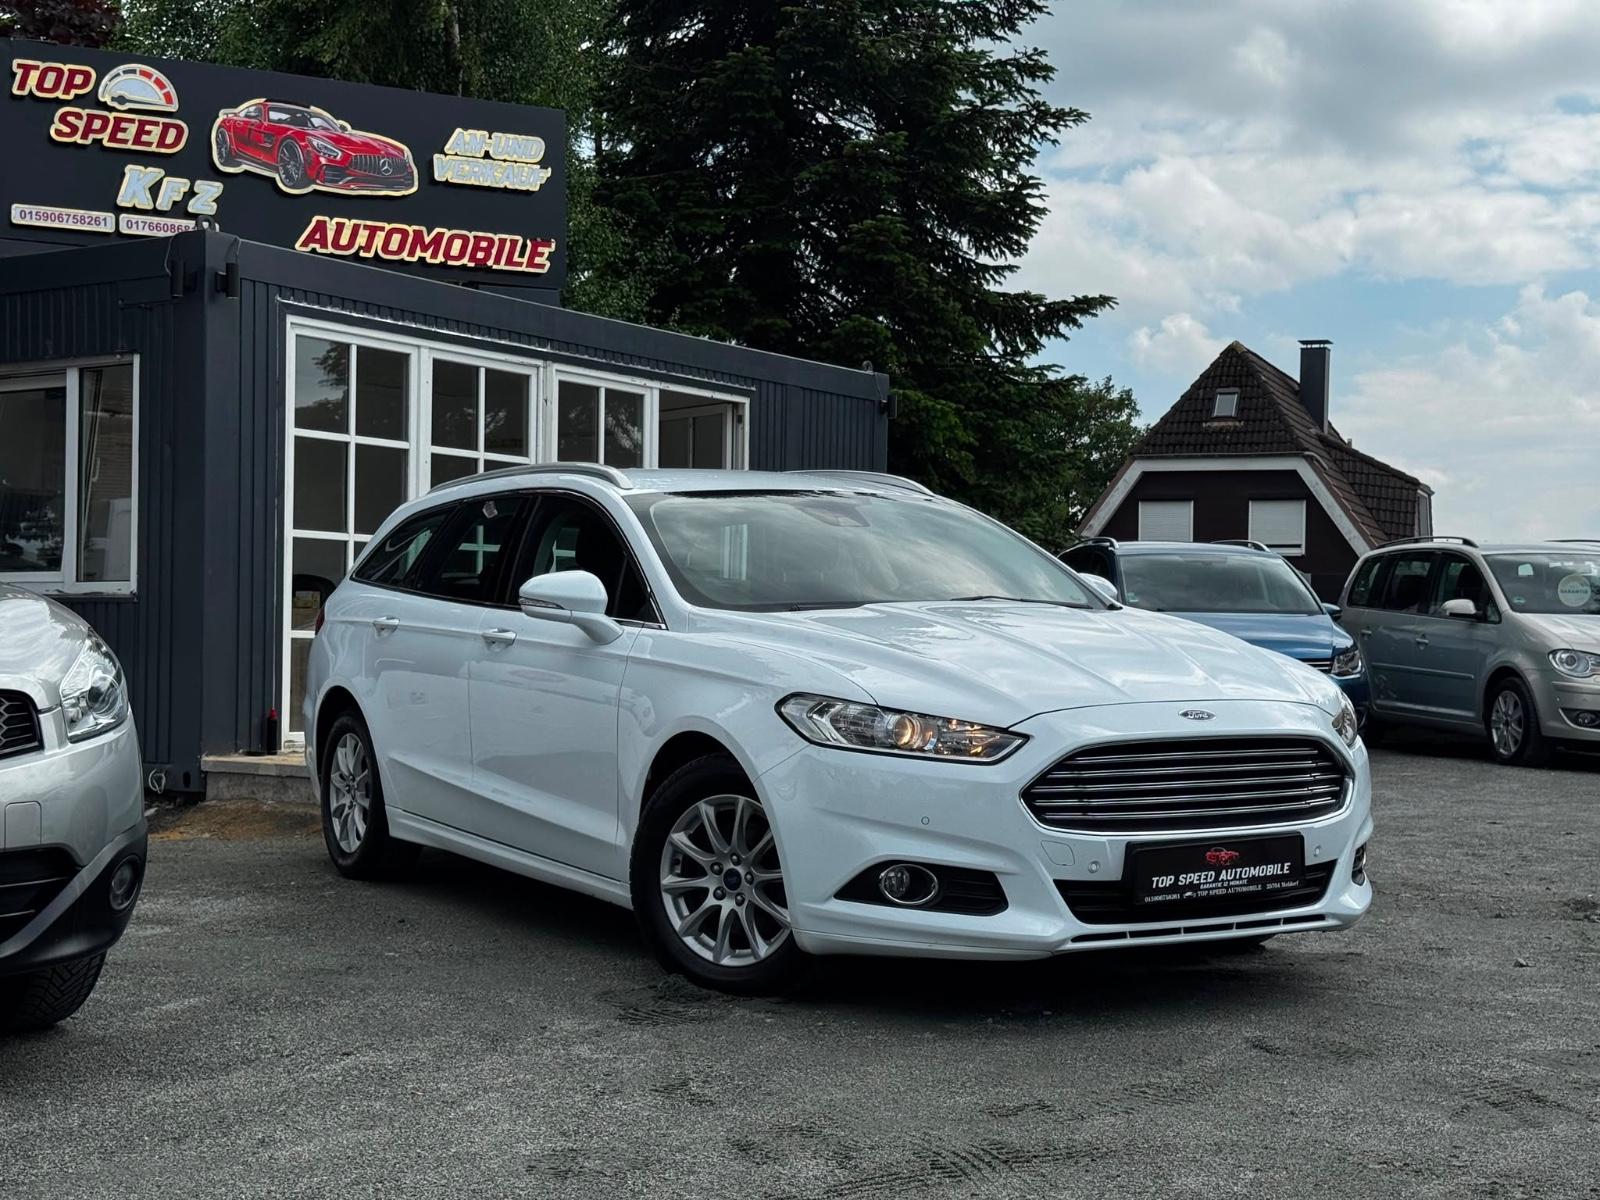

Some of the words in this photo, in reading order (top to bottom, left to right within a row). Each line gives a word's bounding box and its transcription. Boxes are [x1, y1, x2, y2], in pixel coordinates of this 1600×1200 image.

[13, 60, 95, 99] TOP
[51, 107, 188, 153] SPEED
[433, 154, 551, 191] VERKAUF
[19, 209, 107, 227] 015906758261
[296, 217, 555, 272] AUTOMOBILE
[1152, 876, 1175, 888] TOP
[1178, 871, 1215, 885] SPEED
[1219, 862, 1291, 880] AUTOMOBILE
